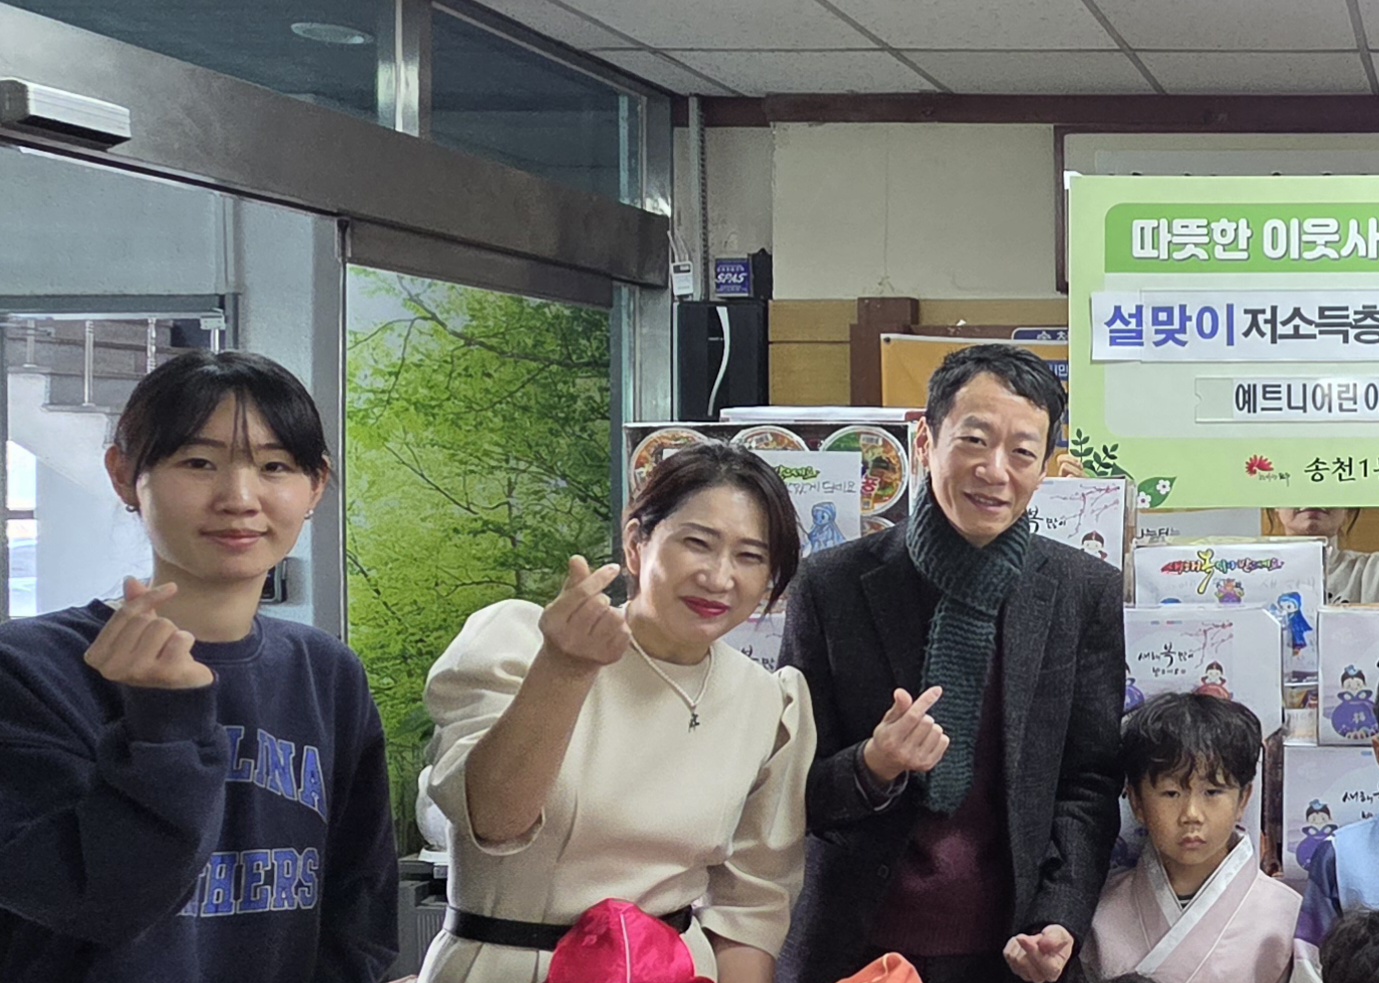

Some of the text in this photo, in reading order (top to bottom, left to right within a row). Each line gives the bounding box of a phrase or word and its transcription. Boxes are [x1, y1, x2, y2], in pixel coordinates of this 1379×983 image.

[1132, 217, 1252, 261] 따뜻한
[716, 272, 748, 284] SPAS
[1104, 303, 1235, 348] 설맞이
[225, 726, 328, 824] LINA
